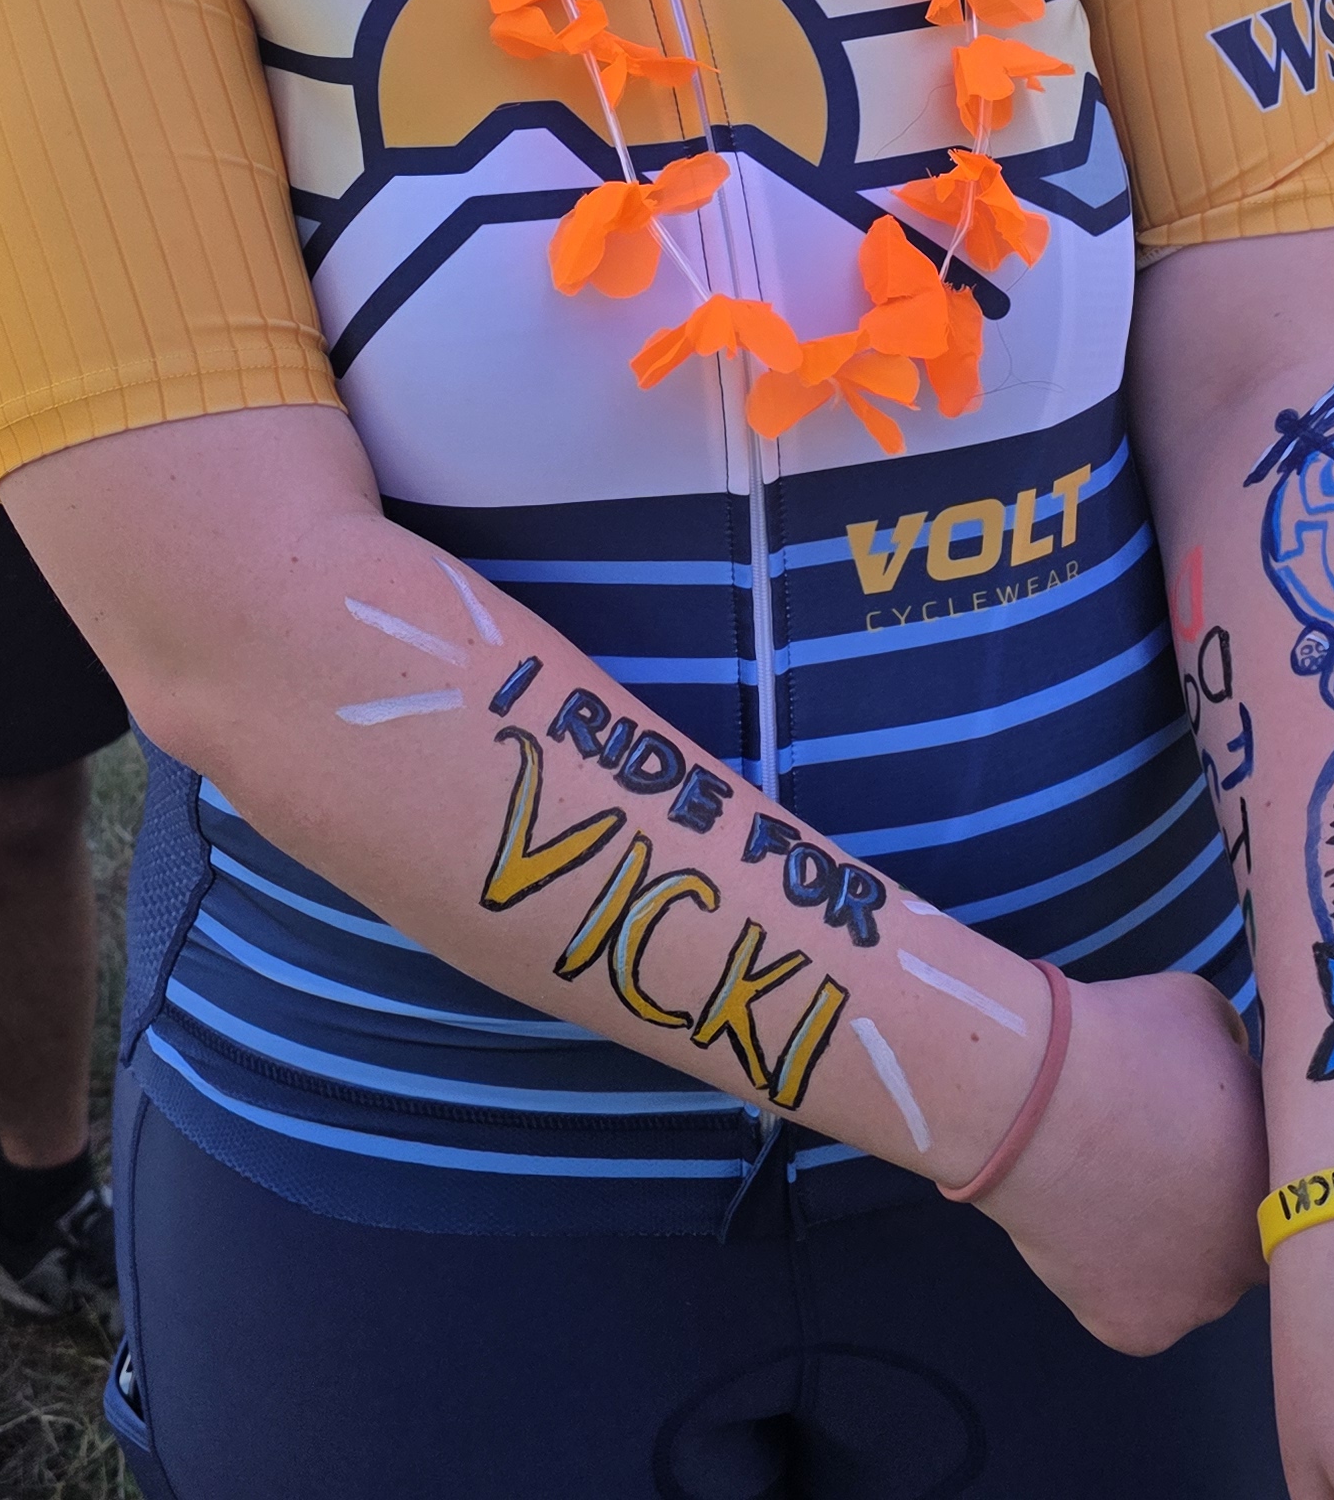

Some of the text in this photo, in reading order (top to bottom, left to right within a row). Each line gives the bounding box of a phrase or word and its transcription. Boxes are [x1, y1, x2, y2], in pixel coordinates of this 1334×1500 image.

[845, 463, 1092, 595] VOLT
[866, 560, 1081, 632] CYCLEWEAR
[488, 655, 887, 947] I RIDE FOR
[479, 726, 851, 1112] VICKI
